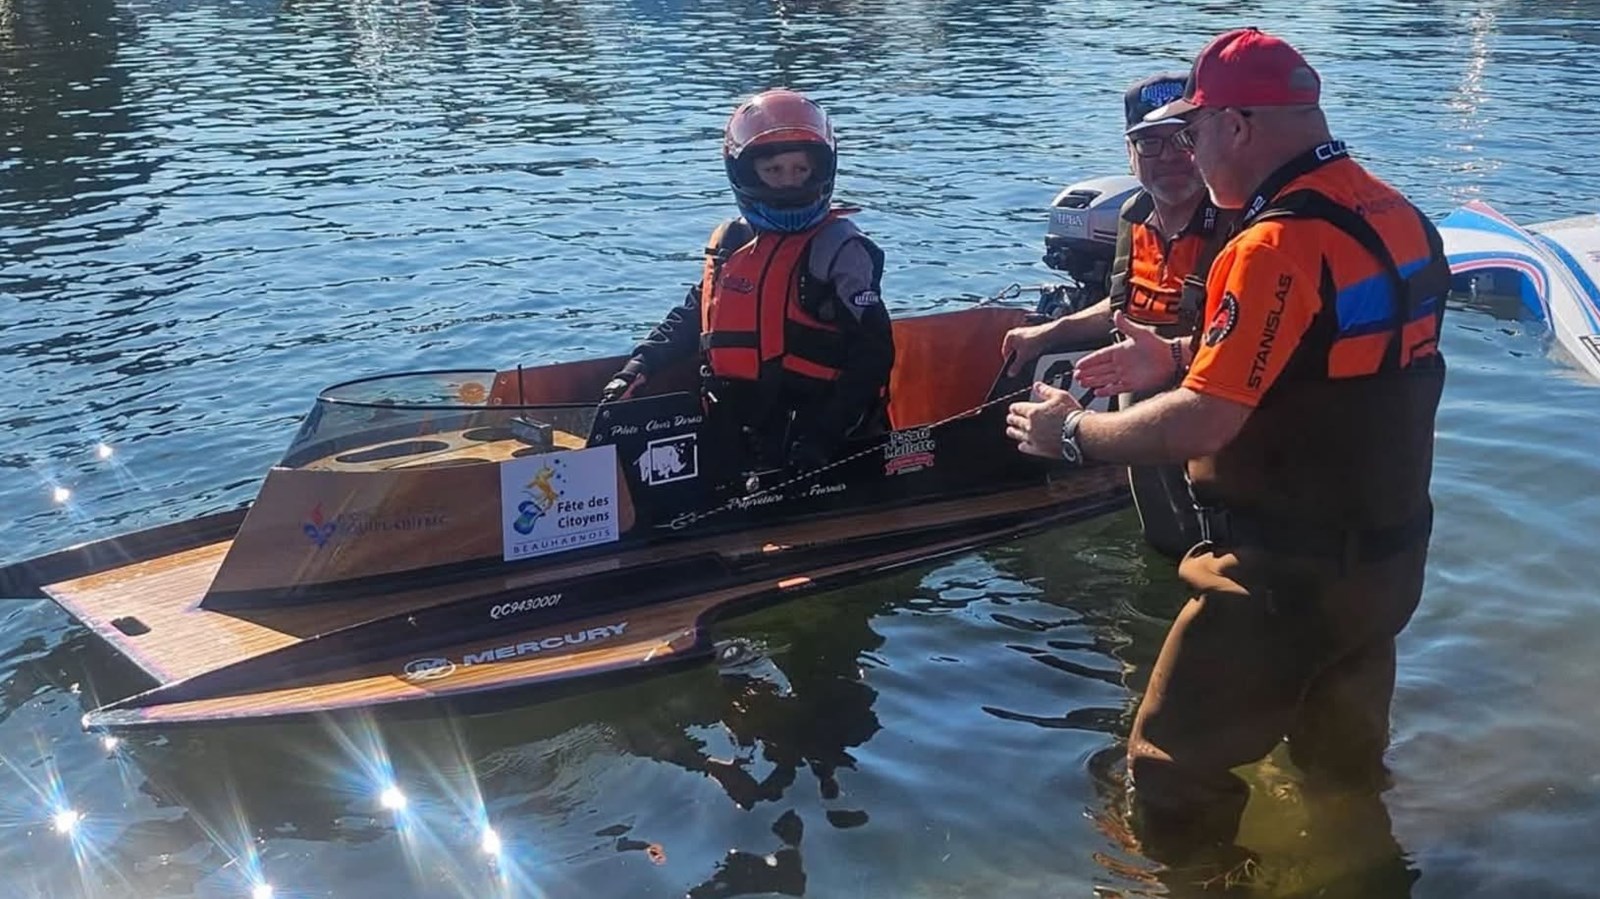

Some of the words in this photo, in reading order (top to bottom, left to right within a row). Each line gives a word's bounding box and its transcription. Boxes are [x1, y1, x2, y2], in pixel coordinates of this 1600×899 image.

[1247, 273, 1293, 389] STANISLAS
[557, 501, 585, 514] Fête
[588, 496, 610, 508] des
[558, 511, 610, 529] Citoyens
[513, 529, 611, 554] BEAUHARNOIS
[490, 593, 562, 620] QC9430001
[463, 621, 629, 667] MERCURY
